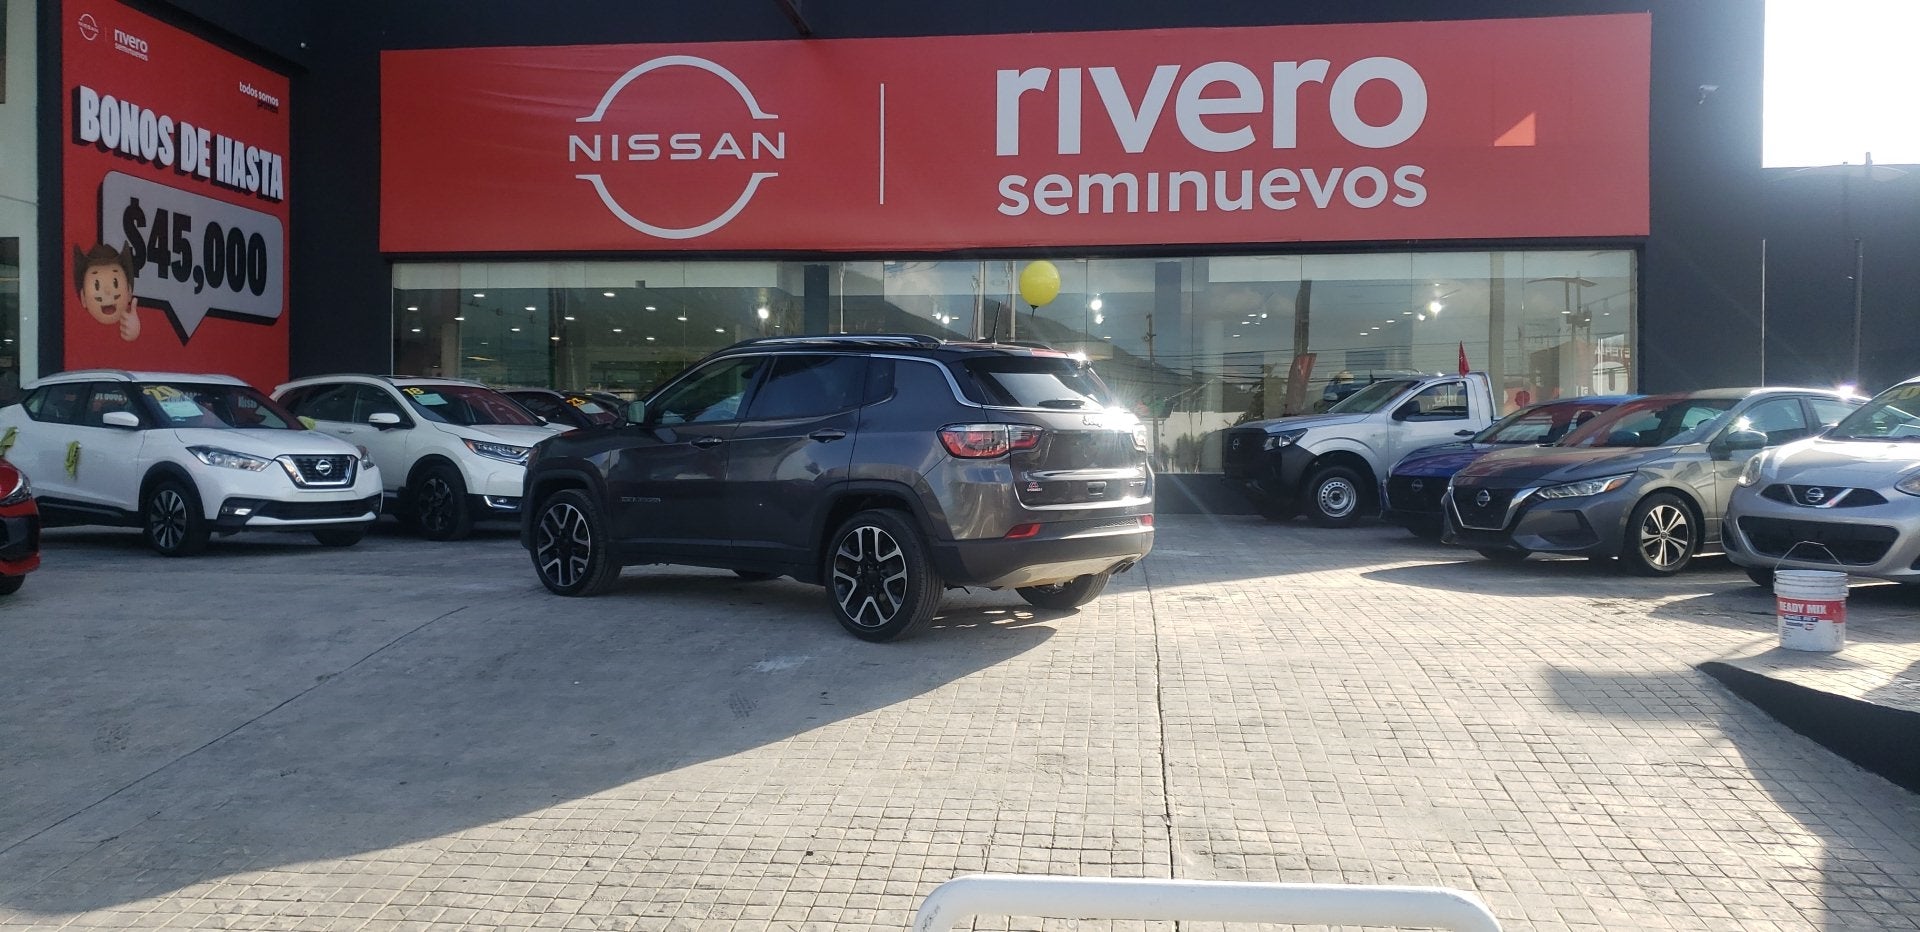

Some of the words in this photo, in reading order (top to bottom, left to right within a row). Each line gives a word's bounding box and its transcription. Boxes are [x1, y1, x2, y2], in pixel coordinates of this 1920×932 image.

[115, 29, 148, 53] rivero
[240, 81, 258, 98] todos
[259, 91, 279, 106] somos
[997, 57, 1427, 156] rivero
[80, 85, 174, 167] BONOS
[181, 121, 211, 178] DE
[216, 134, 283, 200] HASTA
[569, 132, 784, 162] NISSAN
[998, 165, 1427, 216] seminuevos
[123, 197, 267, 296] $45,000
[402, 387, 424, 396] 18
[566, 397, 586, 407] 23
[1806, 604, 1827, 614] MIX
